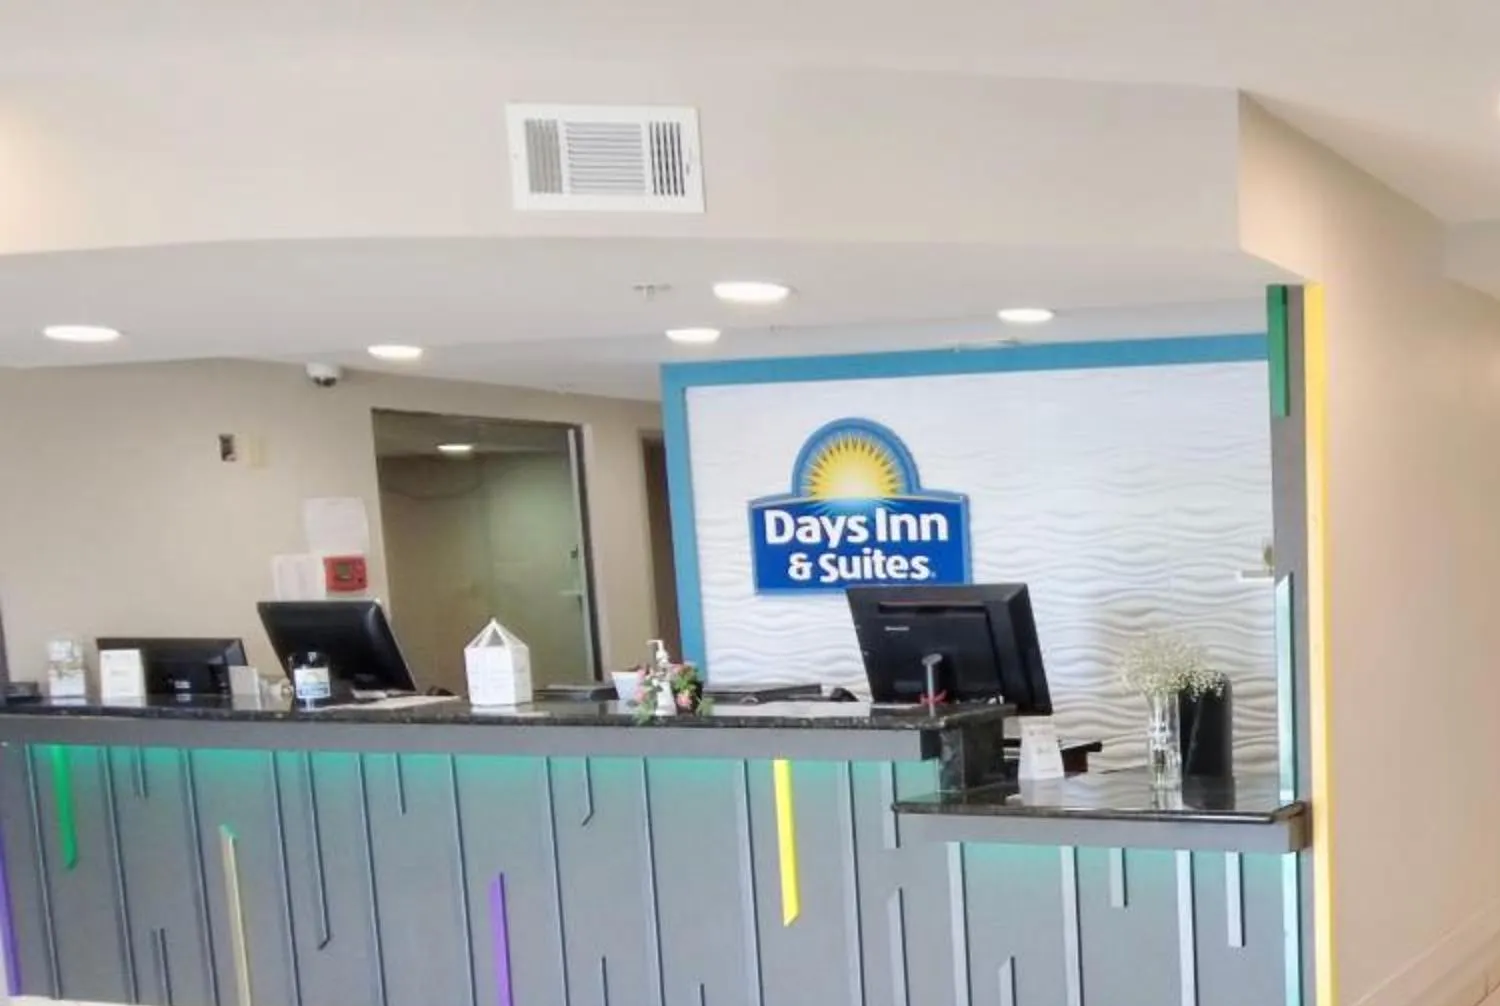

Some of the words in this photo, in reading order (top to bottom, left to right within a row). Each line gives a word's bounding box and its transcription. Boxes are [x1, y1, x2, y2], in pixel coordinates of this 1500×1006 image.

[764, 509, 869, 548] Days
[875, 508, 949, 542] Inn
[787, 552, 812, 580] &
[818, 547, 931, 583] Suites
